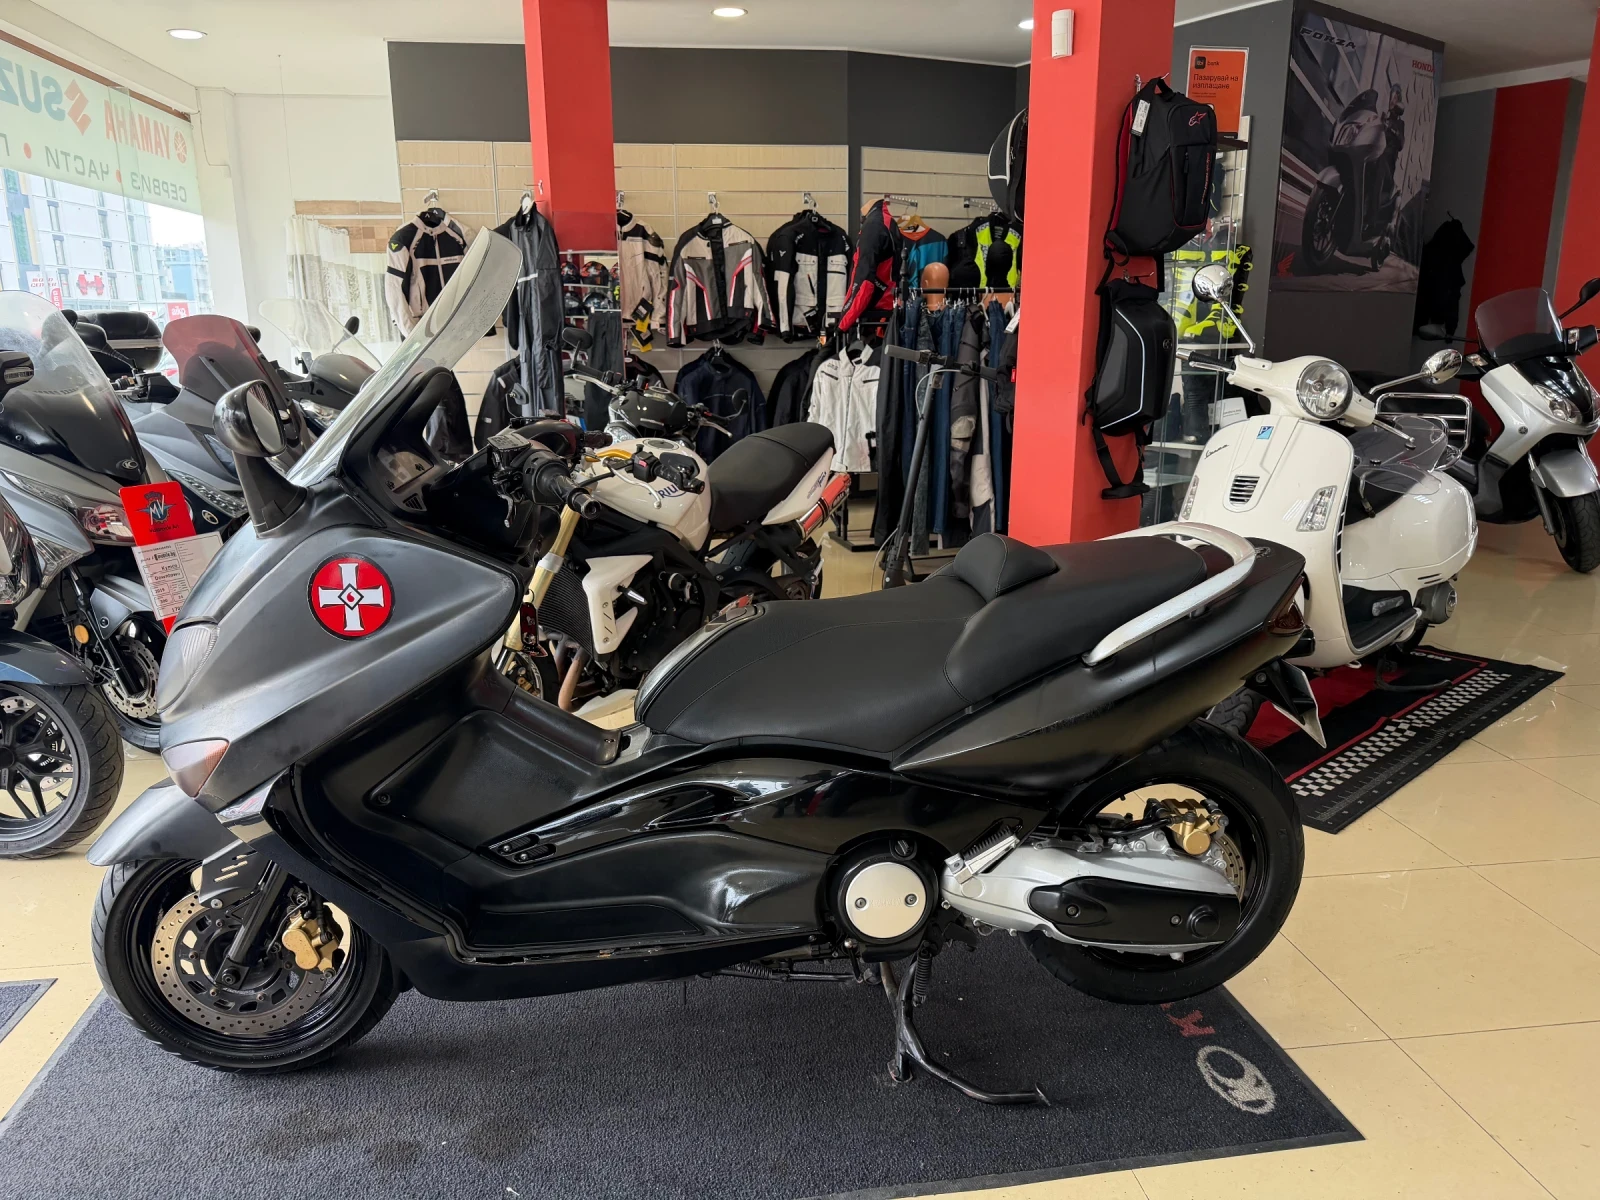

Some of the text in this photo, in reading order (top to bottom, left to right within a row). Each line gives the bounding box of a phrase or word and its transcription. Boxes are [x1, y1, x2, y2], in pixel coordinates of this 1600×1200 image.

[1300, 27, 1356, 49] FORZA
[1412, 59, 1435, 73] HONDA
[1193, 73, 1229, 82] Пазарувай
